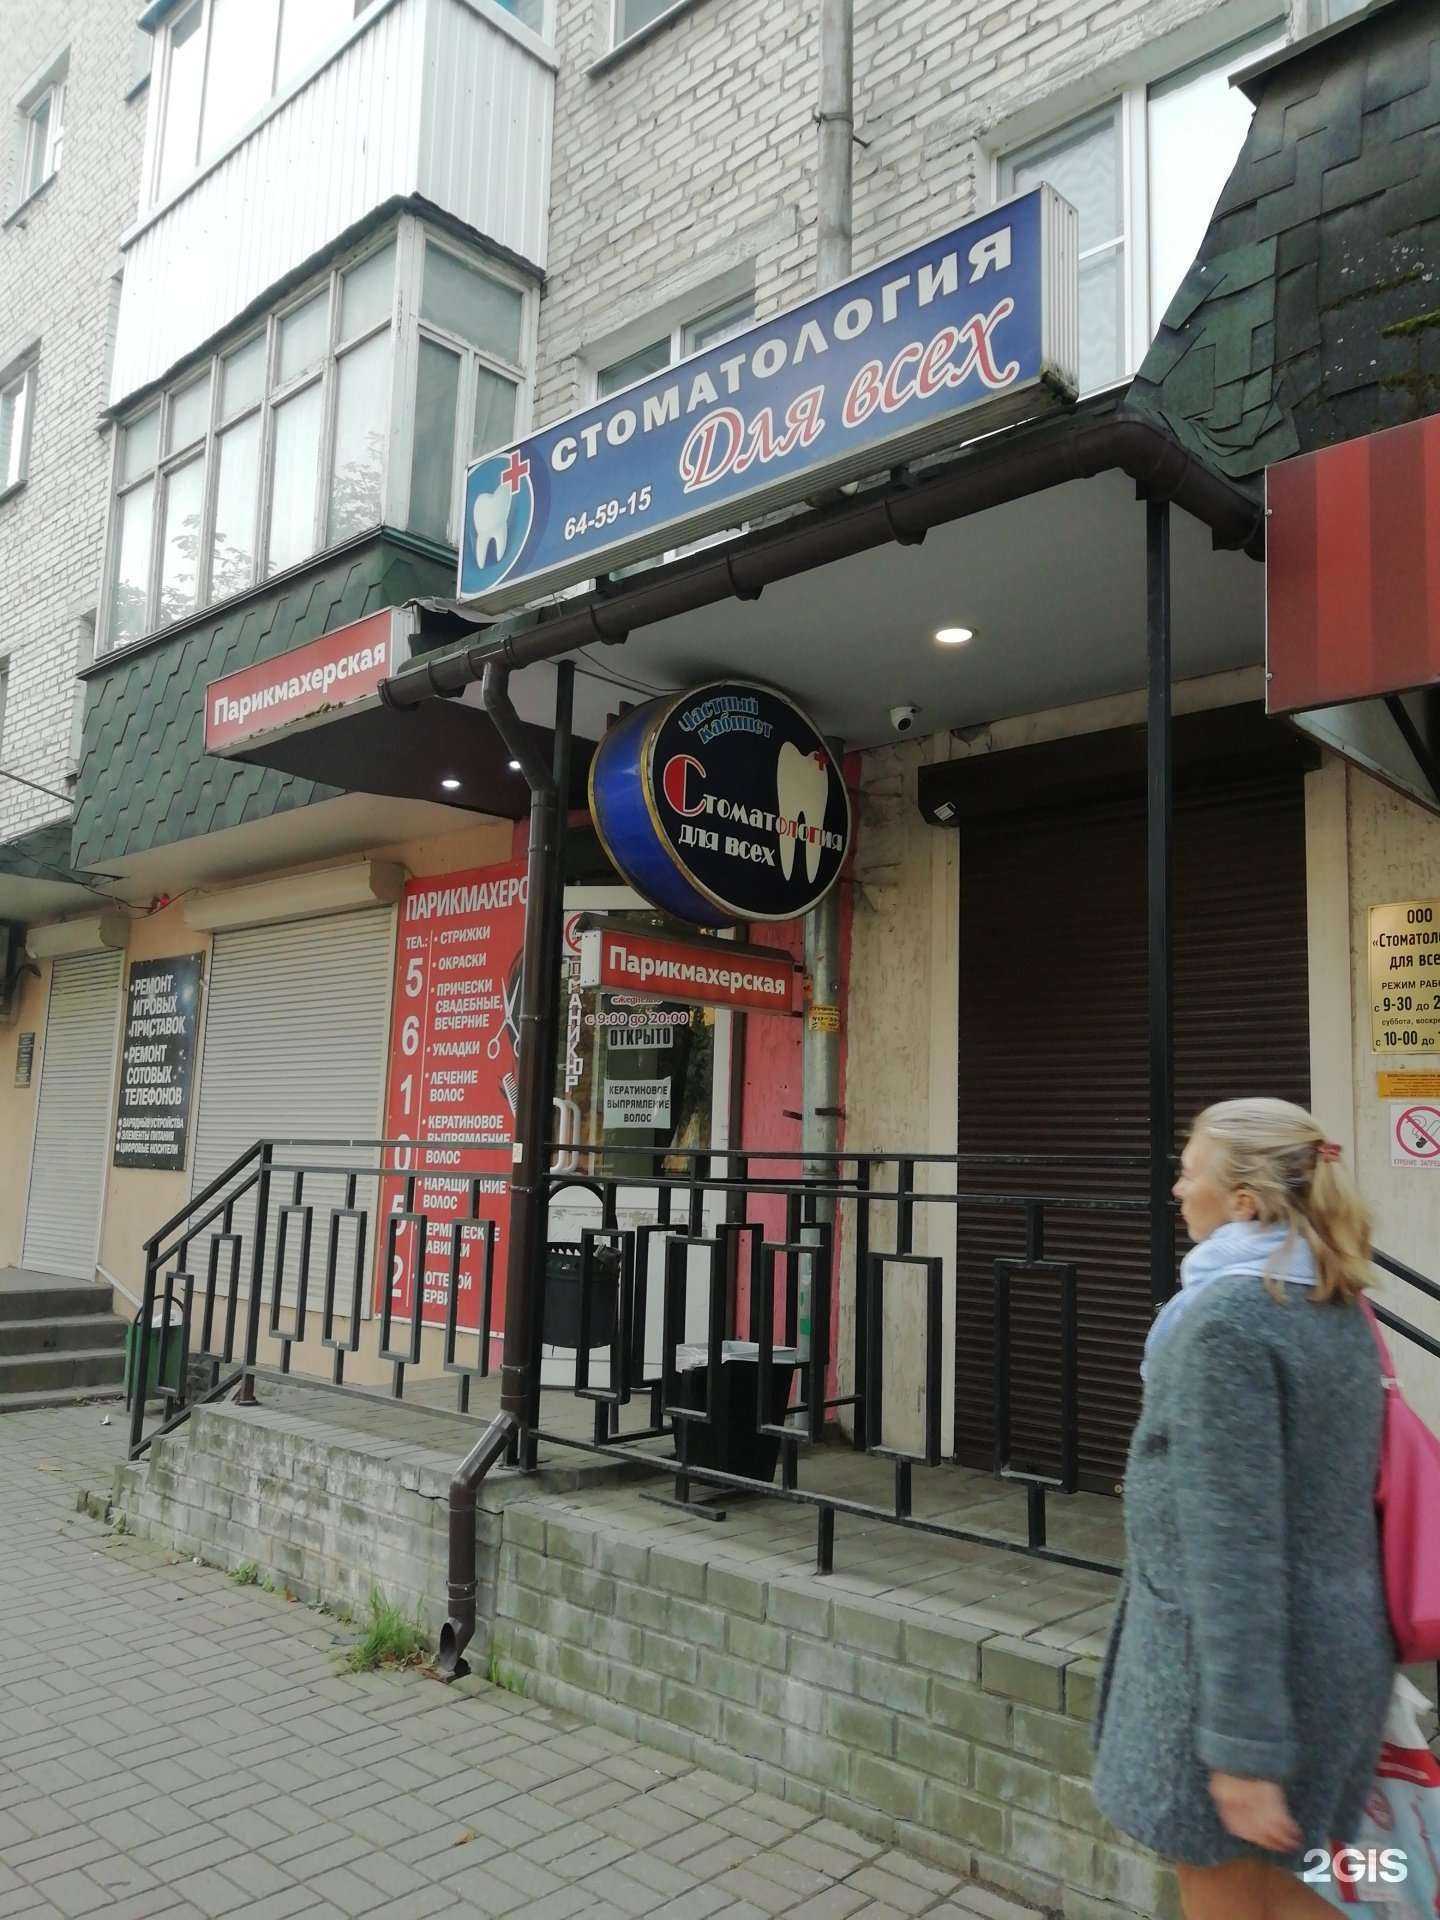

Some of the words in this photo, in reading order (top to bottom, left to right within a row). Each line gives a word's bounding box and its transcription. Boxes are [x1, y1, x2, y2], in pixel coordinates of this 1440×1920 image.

[549, 225, 1014, 473] СТОМАТОЛОГИЯ
[679, 386, 826, 495] Для
[841, 296, 1022, 429] всех
[562, 486, 655, 542] 64-59-15
[212, 641, 387, 726] Парикмахерская
[663, 753, 844, 852] Стоматология
[678, 823, 719, 851] для
[724, 834, 776, 867] всех
[1406, 907, 1433, 923] ООО
[440, 926, 490, 944] СТРИЖКИ
[1372, 931, 1440, 948] «Стоматол
[438, 953, 487, 971] ОКРАСКИ
[609, 945, 786, 996] Парикмахерская
[1390, 954, 1413, 970] для
[134, 975, 174, 996] РЕМОНТ
[405, 957, 423, 998] 5
[1381, 980, 1416, 990] РЕЖИМ
[1419, 979, 1440, 988] РАБ
[436, 979, 493, 997] ПРИЧЕСКИ
[132, 995, 178, 1017] ИГРОВЫХ
[1383, 996, 1413, 1012] 9-30
[1416, 1003, 1430, 1012] до
[130, 1016, 187, 1038] ПРИСТАВОК
[434, 1013, 490, 1031] ВЕЧЕРНИЕ
[596, 1011, 628, 1026] 9:00
[647, 1011, 690, 1025] 20:00
[402, 1015, 420, 1056] 6
[610, 1027, 671, 1046] ОТКРЫТО
[1384, 1030, 1419, 1046] 10-00
[1421, 1038, 1435, 1047] до
[128, 1044, 168, 1064] РЕМОНТ
[432, 1041, 480, 1058] УКЛАДКИ
[126, 1065, 173, 1085] СОТОВЫХ
[430, 1070, 479, 1085] ЛЕЧЕНИЕ
[125, 1086, 183, 1106] ТЕЛЕФОНОВ
[430, 1088, 465, 1102] ВОЛОС
[609, 1085, 668, 1095] КЕРАТИНОВОЕ
[428, 1115, 504, 1129] КЕРАТИНОВОЕ
[623, 1113, 652, 1122] ВОЛОС
[426, 1150, 461, 1164] ВОЛОС
[423, 1177, 508, 1194] НАРАЩИАНИЕ
[423, 1194, 458, 1210] ВОЛОС
